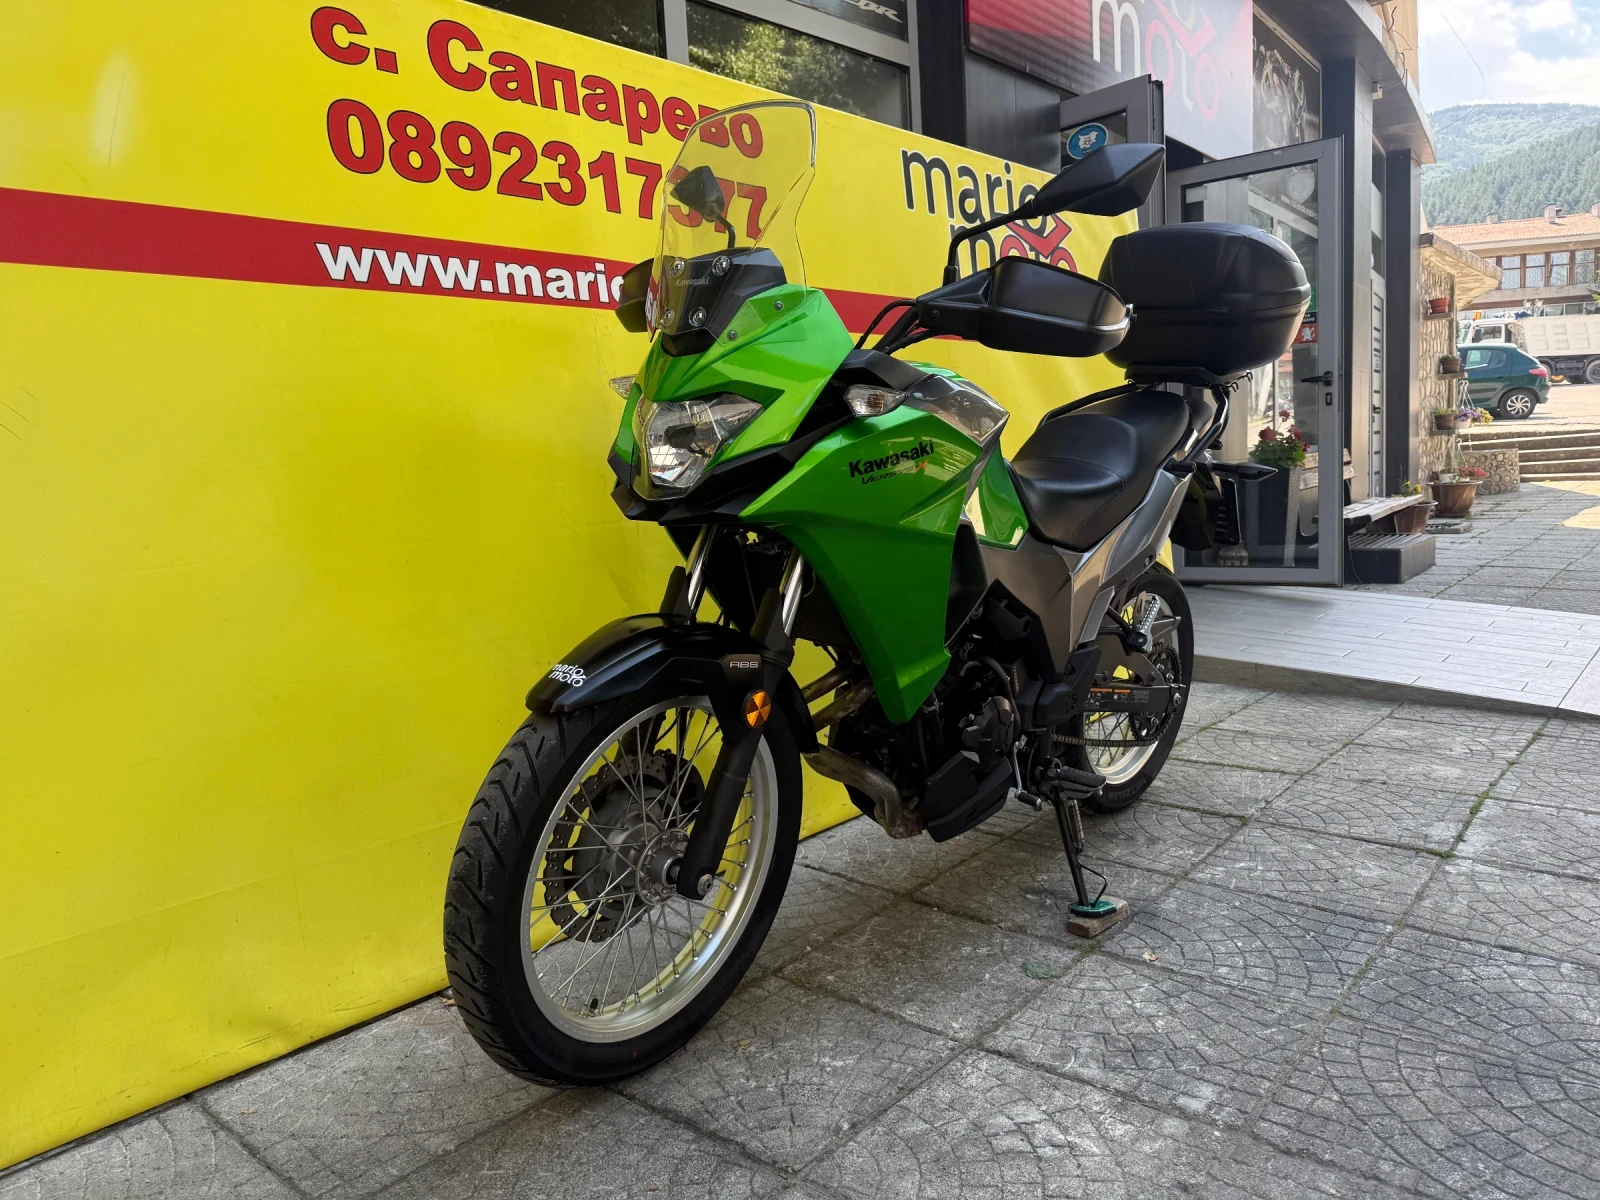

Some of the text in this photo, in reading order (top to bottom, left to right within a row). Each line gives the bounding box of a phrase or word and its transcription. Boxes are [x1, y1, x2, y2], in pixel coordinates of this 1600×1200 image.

[427, 19, 763, 159] Сапарево
[675, 277, 709, 286] Kawasaki
[848, 439, 934, 478] Kawasaki
[552, 664, 584, 676] mario
[729, 661, 759, 669] ABS
[549, 671, 587, 687] moto
